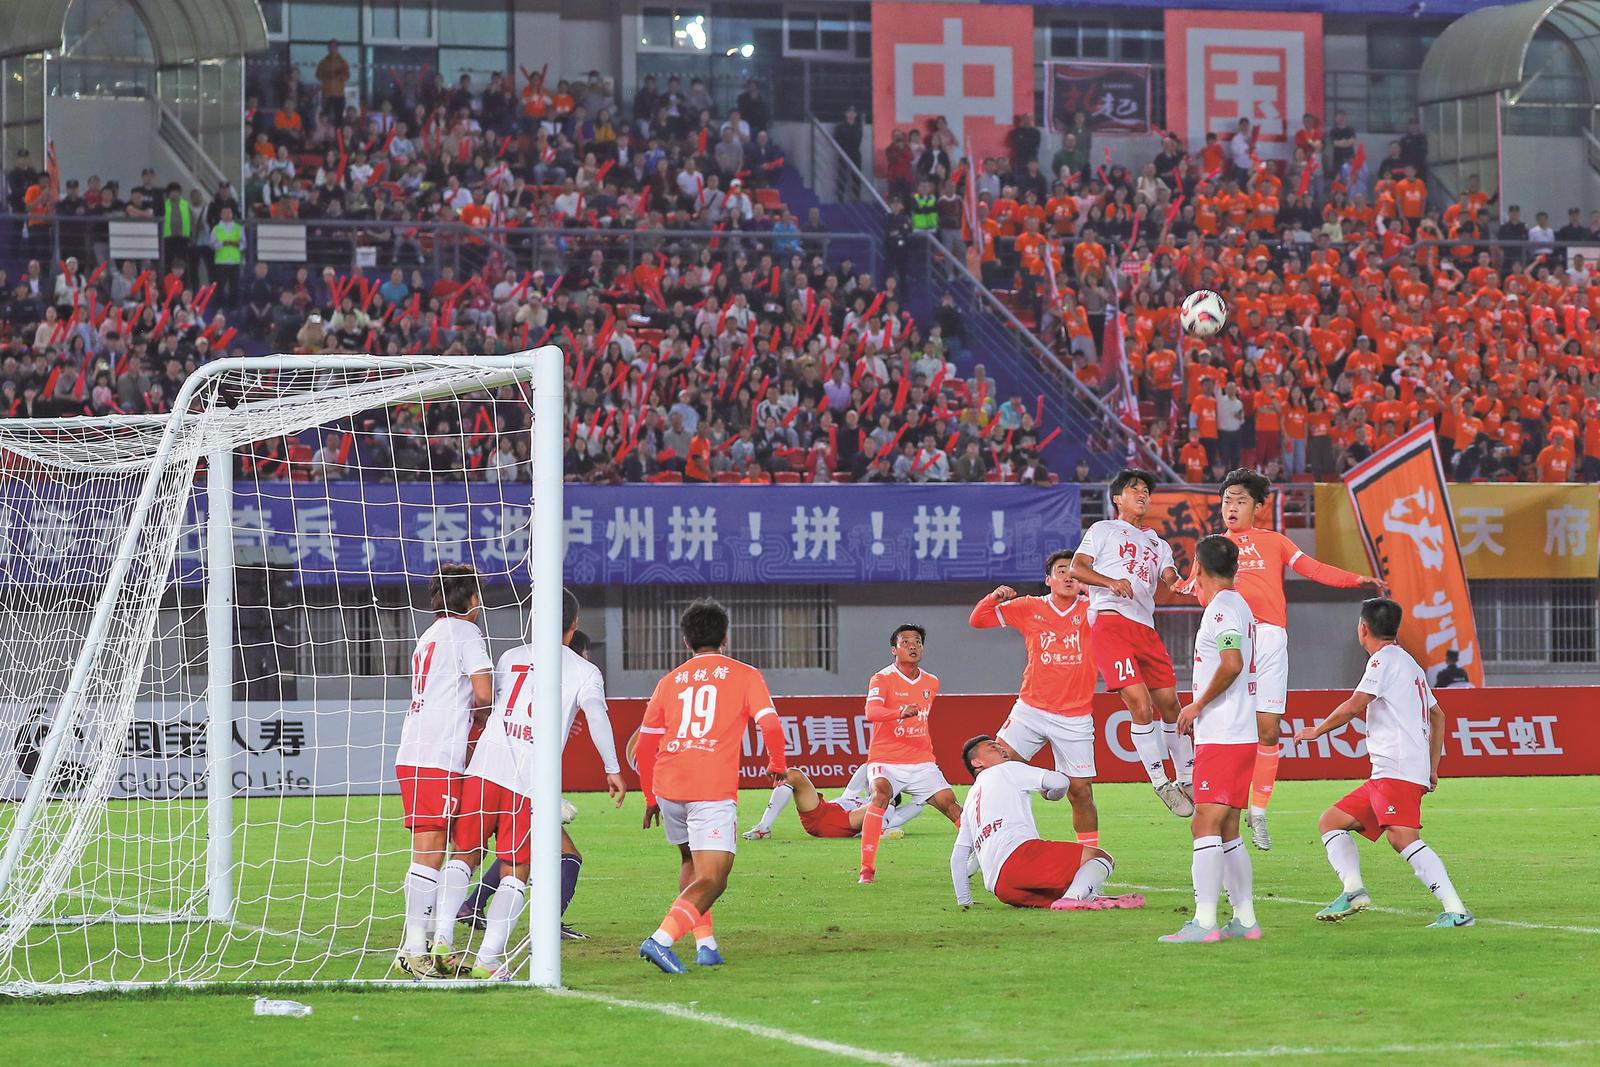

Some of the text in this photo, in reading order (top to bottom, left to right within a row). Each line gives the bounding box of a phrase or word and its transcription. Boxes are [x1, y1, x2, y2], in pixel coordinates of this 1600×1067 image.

[894, 18, 1305, 168] 中 国
[1040, 629, 1081, 652] 泸州
[1114, 657, 1136, 682] 24
[504, 664, 532, 718] 7
[677, 684, 718, 739] 19
[1452, 715, 1564, 757] 长虹
[118, 768, 311, 794] GUOBO Life
